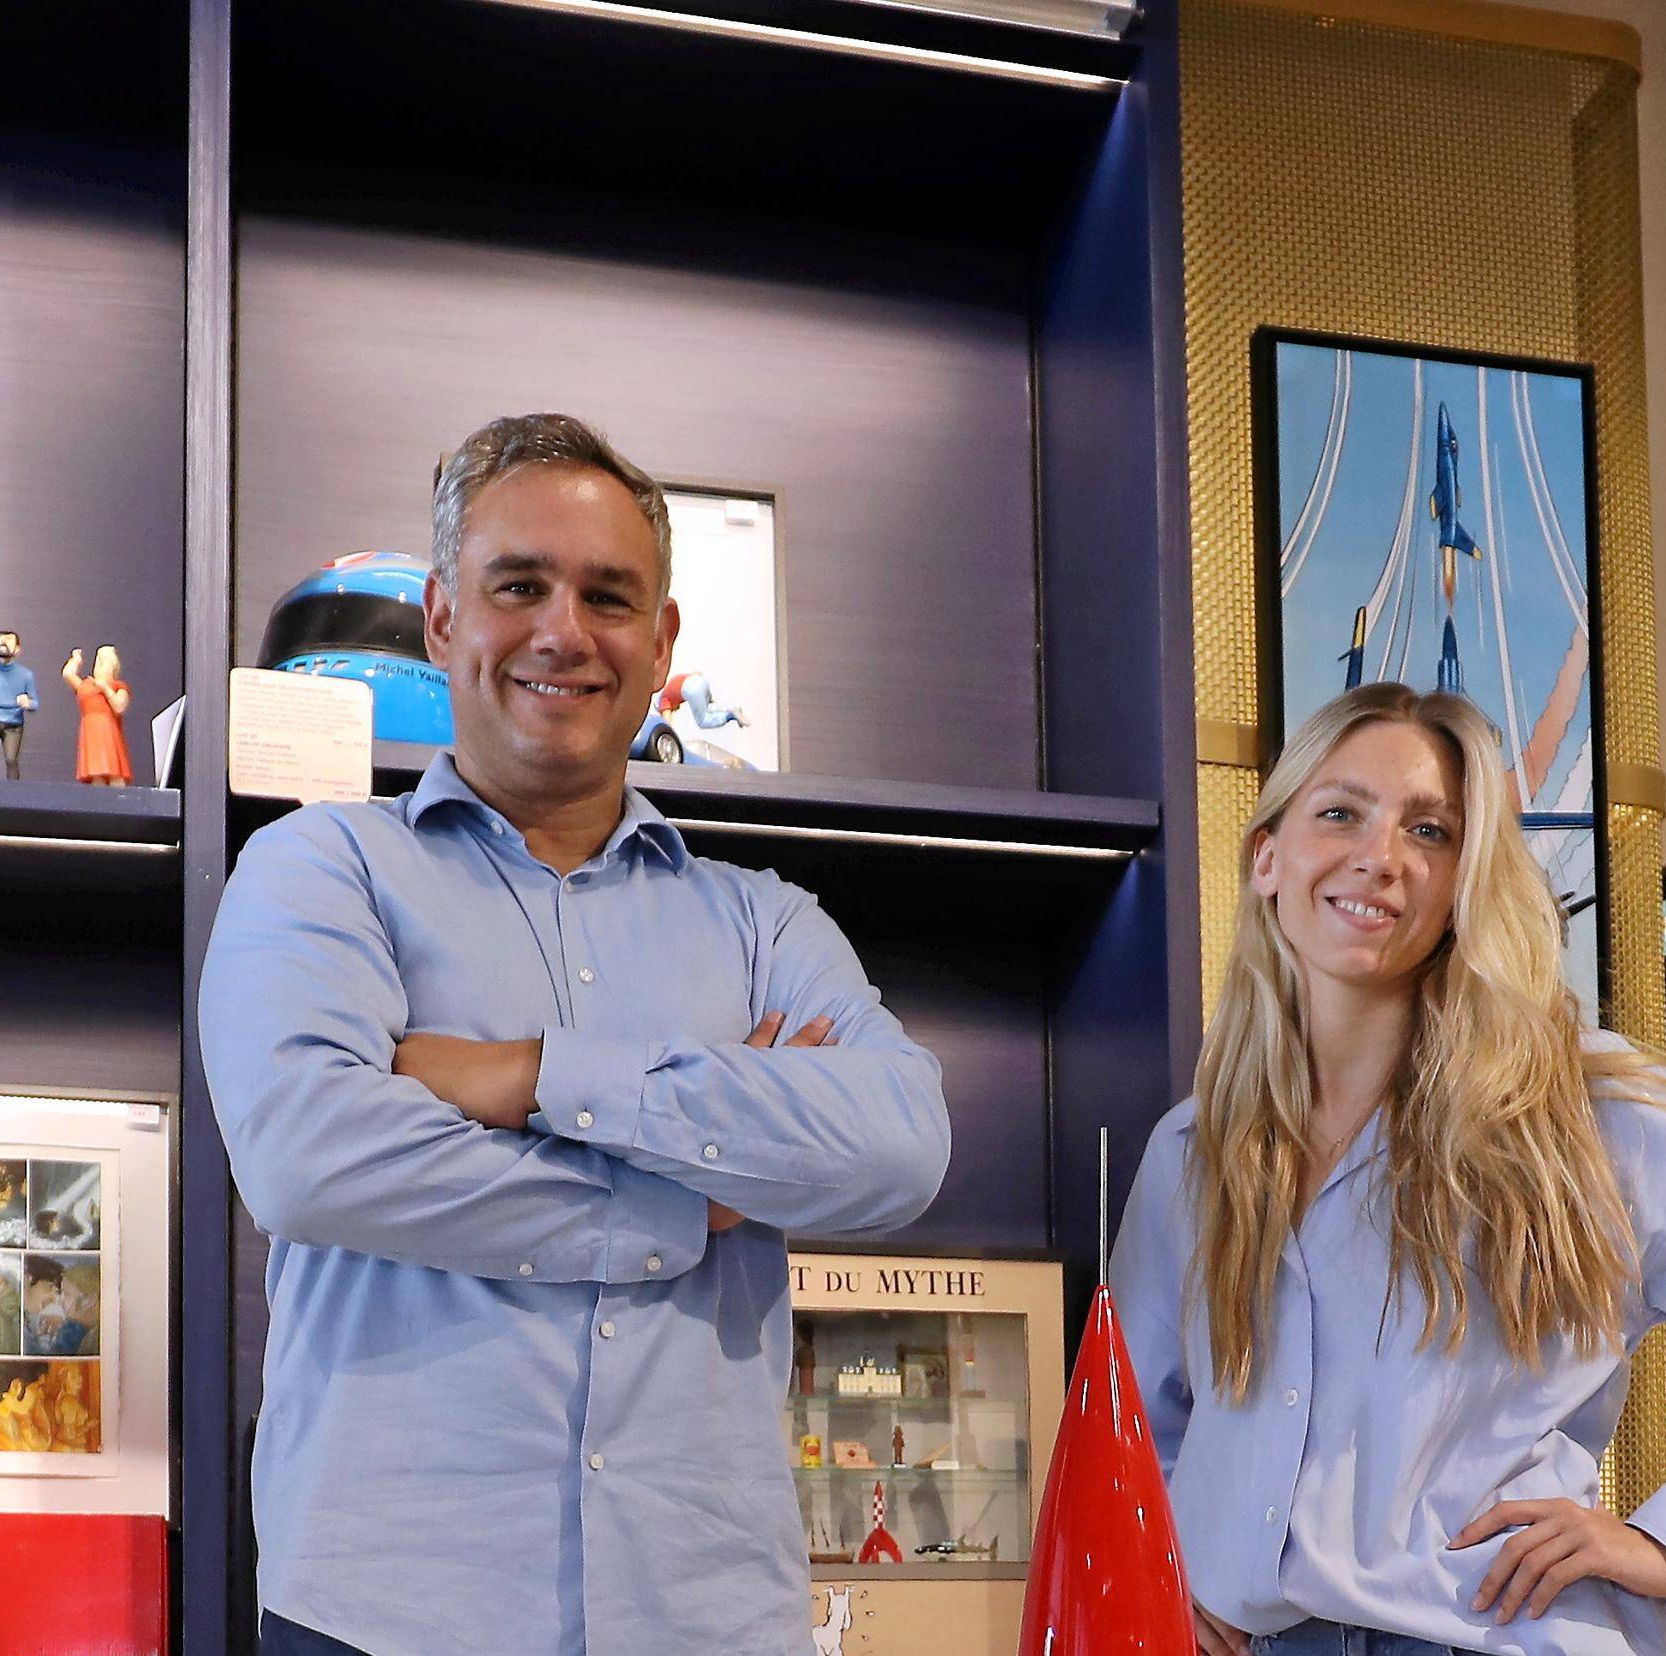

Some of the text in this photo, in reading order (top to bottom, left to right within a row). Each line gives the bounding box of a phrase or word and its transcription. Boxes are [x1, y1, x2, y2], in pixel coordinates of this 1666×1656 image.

[374, 661, 450, 687] Michel Vailla
[825, 1271, 862, 1293] DU
[876, 1268, 986, 1296] MYTHE
